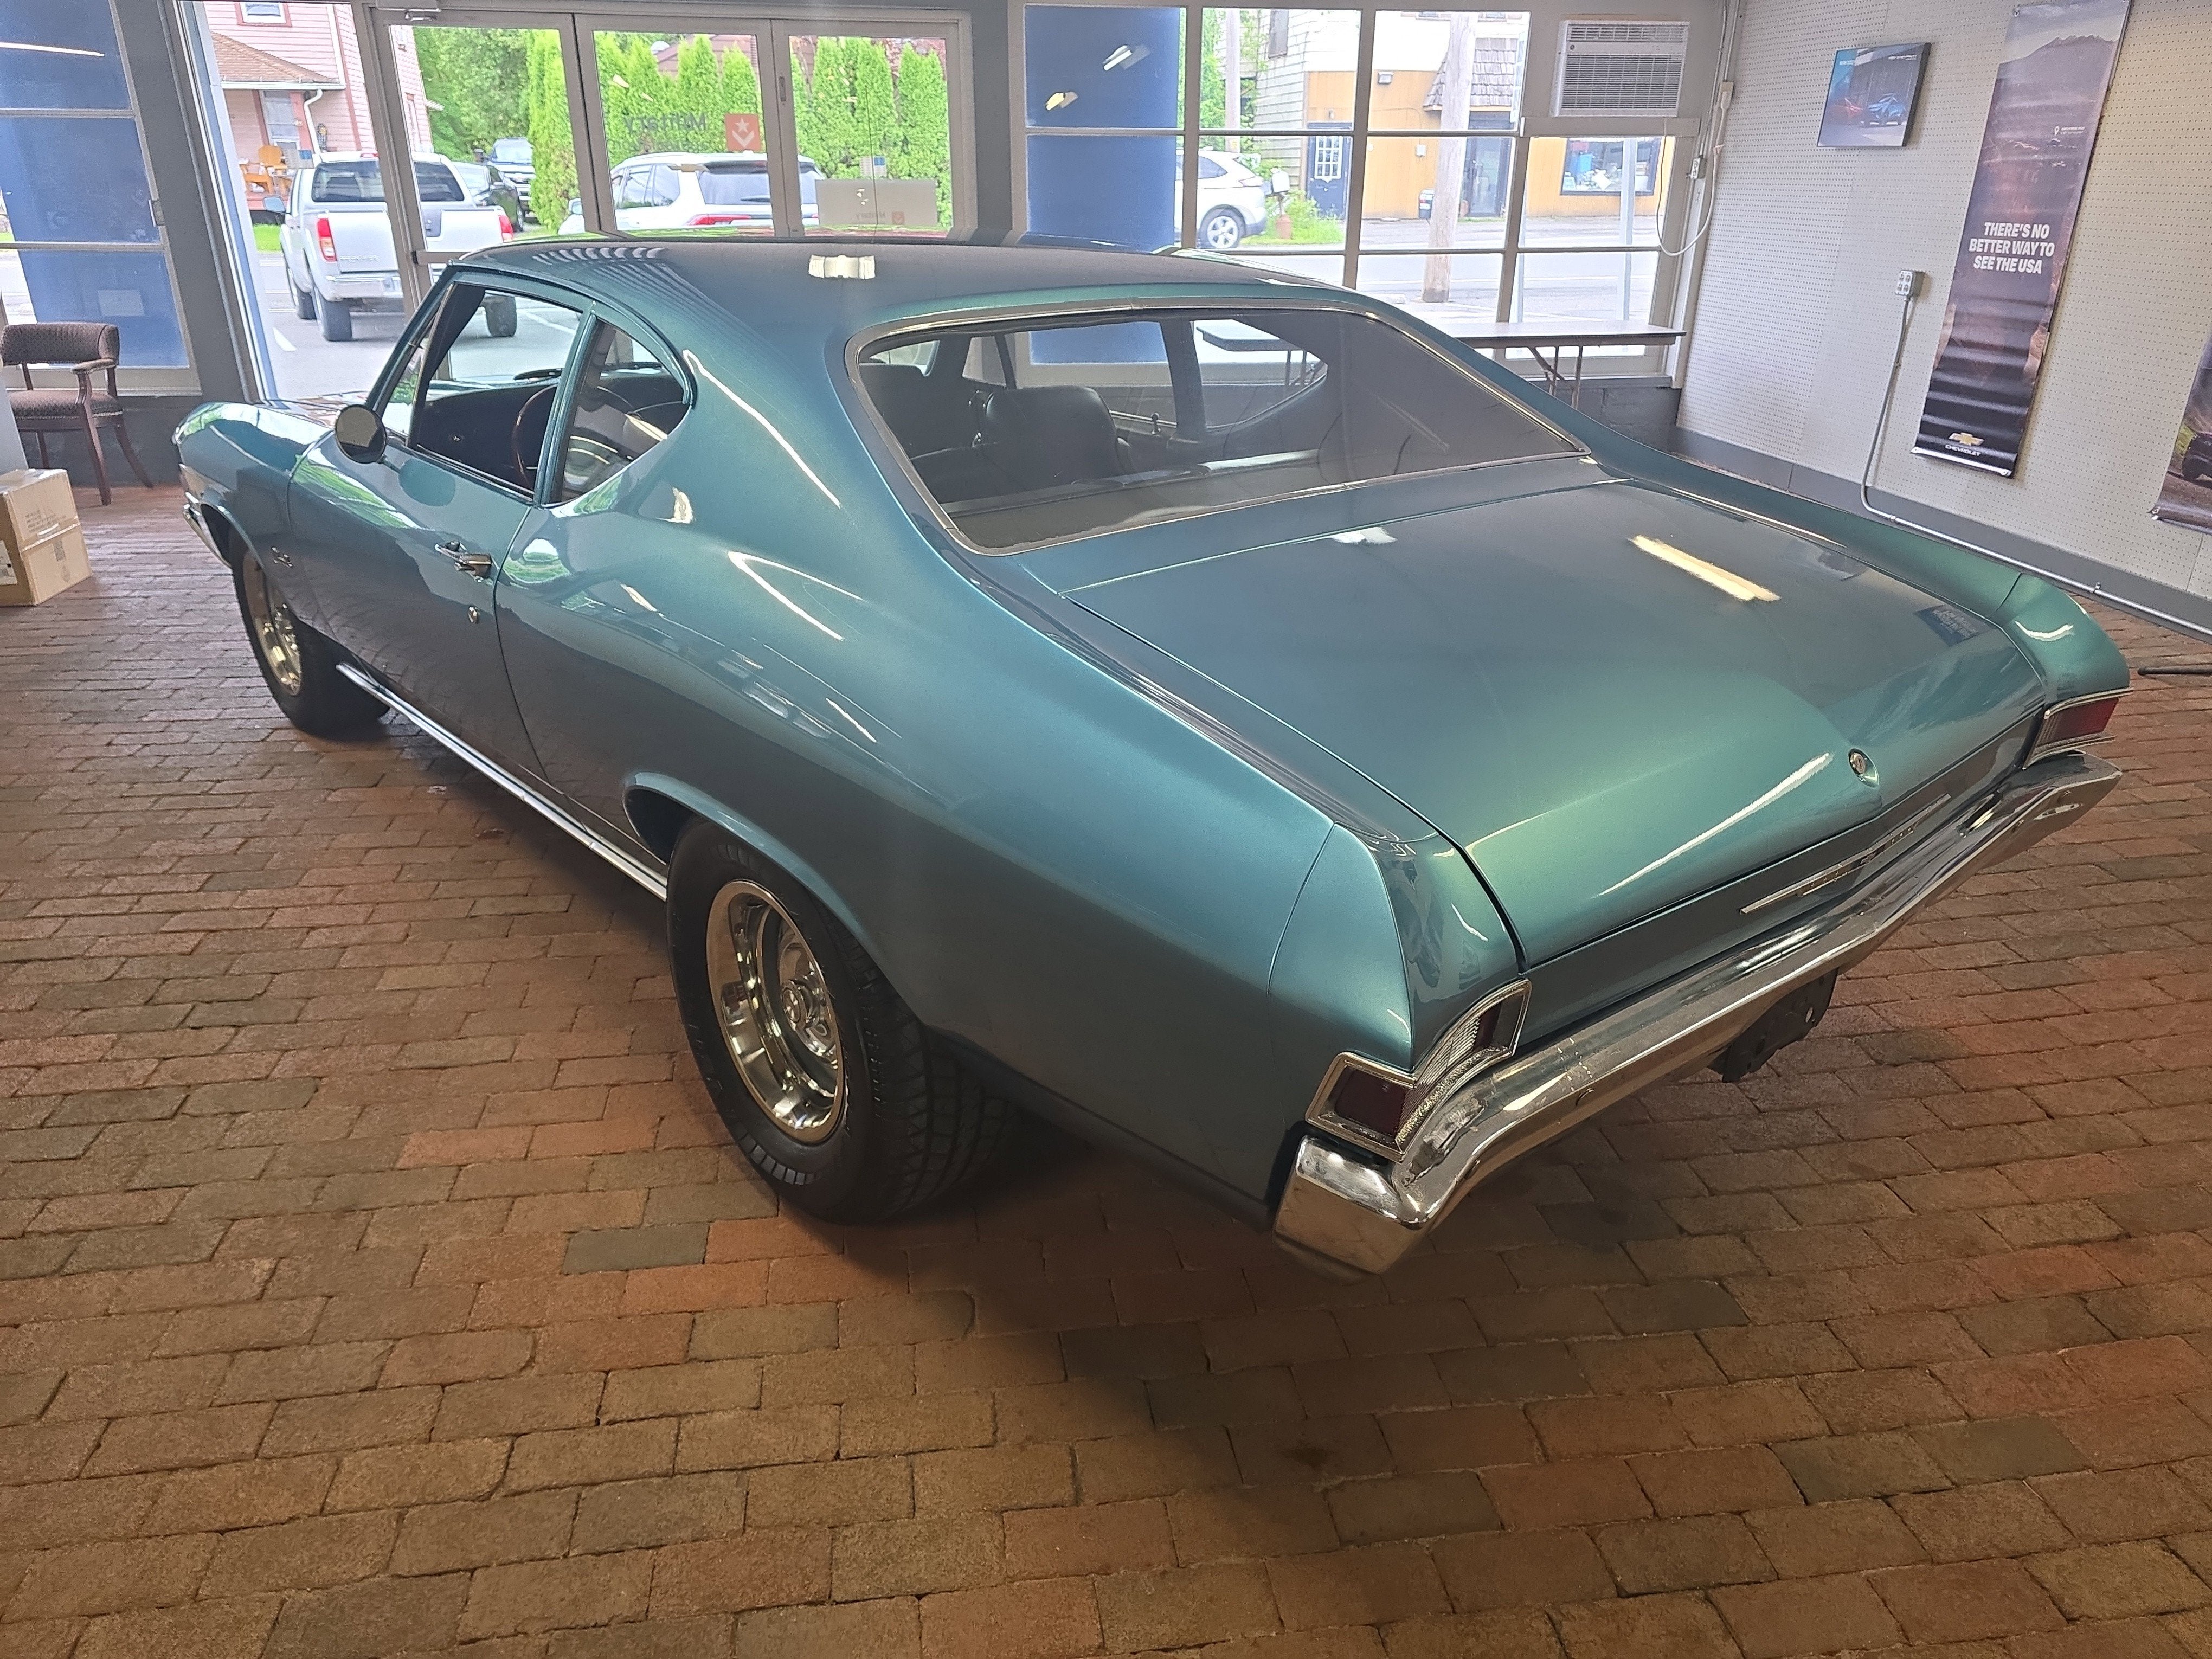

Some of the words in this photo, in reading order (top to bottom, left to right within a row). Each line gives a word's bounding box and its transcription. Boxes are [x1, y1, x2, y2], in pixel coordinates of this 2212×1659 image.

[1984, 222, 2031, 238] THERE'S
[2031, 224, 2050, 239] NO
[1969, 238, 2011, 254] BETTER
[2012, 240, 2039, 256] WAY
[2039, 241, 2055, 257] TO
[1973, 255, 1996, 270] SEE
[1996, 256, 2018, 272] THE
[2018, 258, 2042, 274] USA
